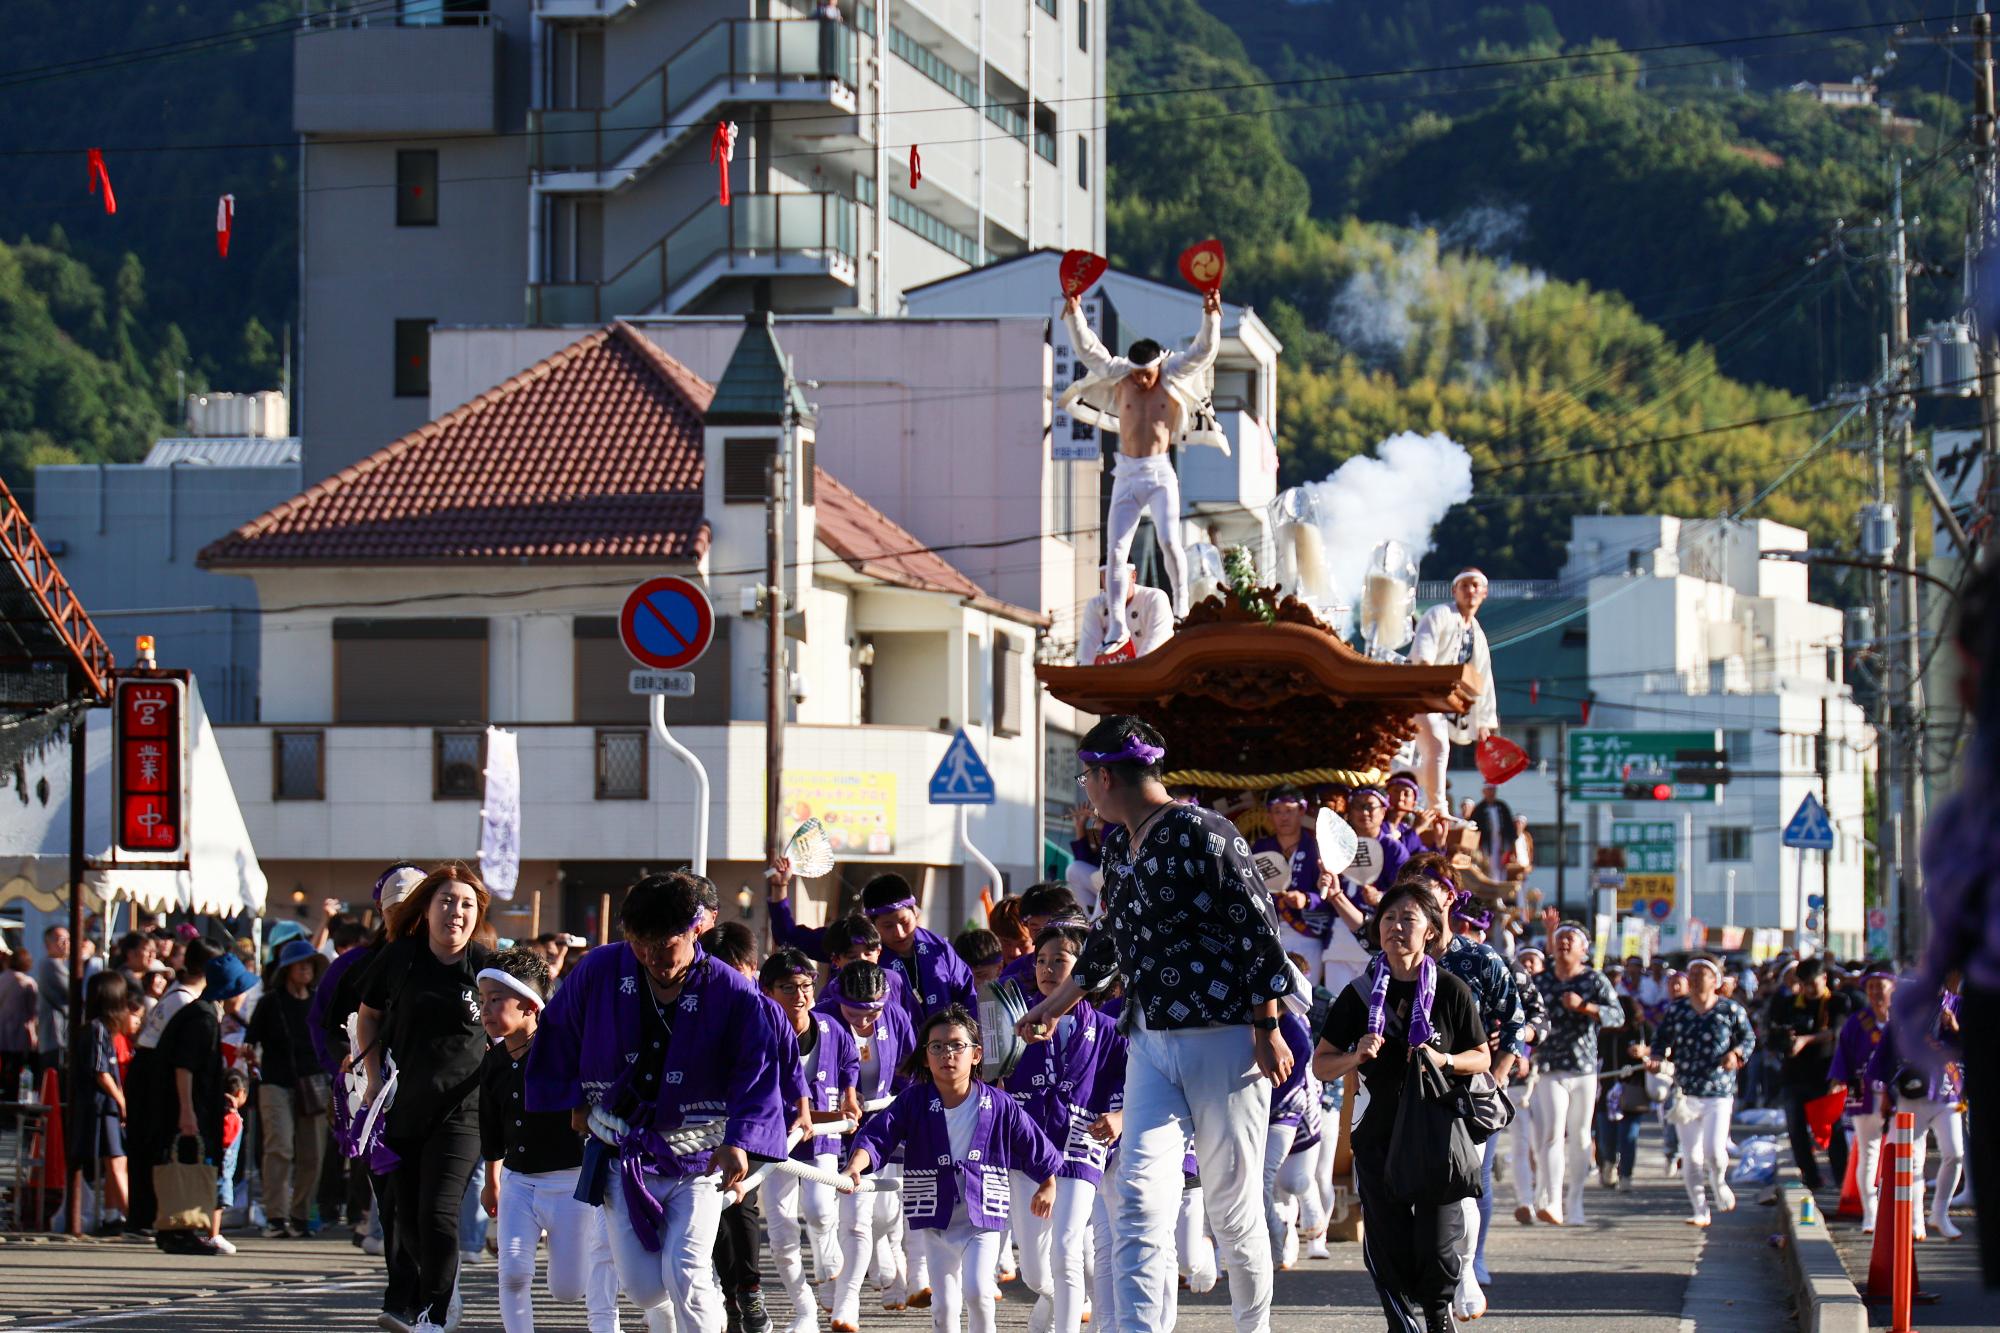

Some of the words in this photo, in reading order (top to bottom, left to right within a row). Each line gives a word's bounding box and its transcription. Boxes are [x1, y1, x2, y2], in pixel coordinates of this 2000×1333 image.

[1055, 344, 1070, 428] 和歌山店
[133, 689, 168, 839] 営業中
[619, 975, 637, 995] 原
[680, 994, 699, 1012] 原
[666, 1071, 684, 1085] 田
[1031, 1074, 1045, 1087] 田
[929, 1097, 943, 1113] 原
[979, 1095, 993, 1110] 原
[938, 1153, 951, 1166] 田
[968, 1149, 981, 1161] 田
